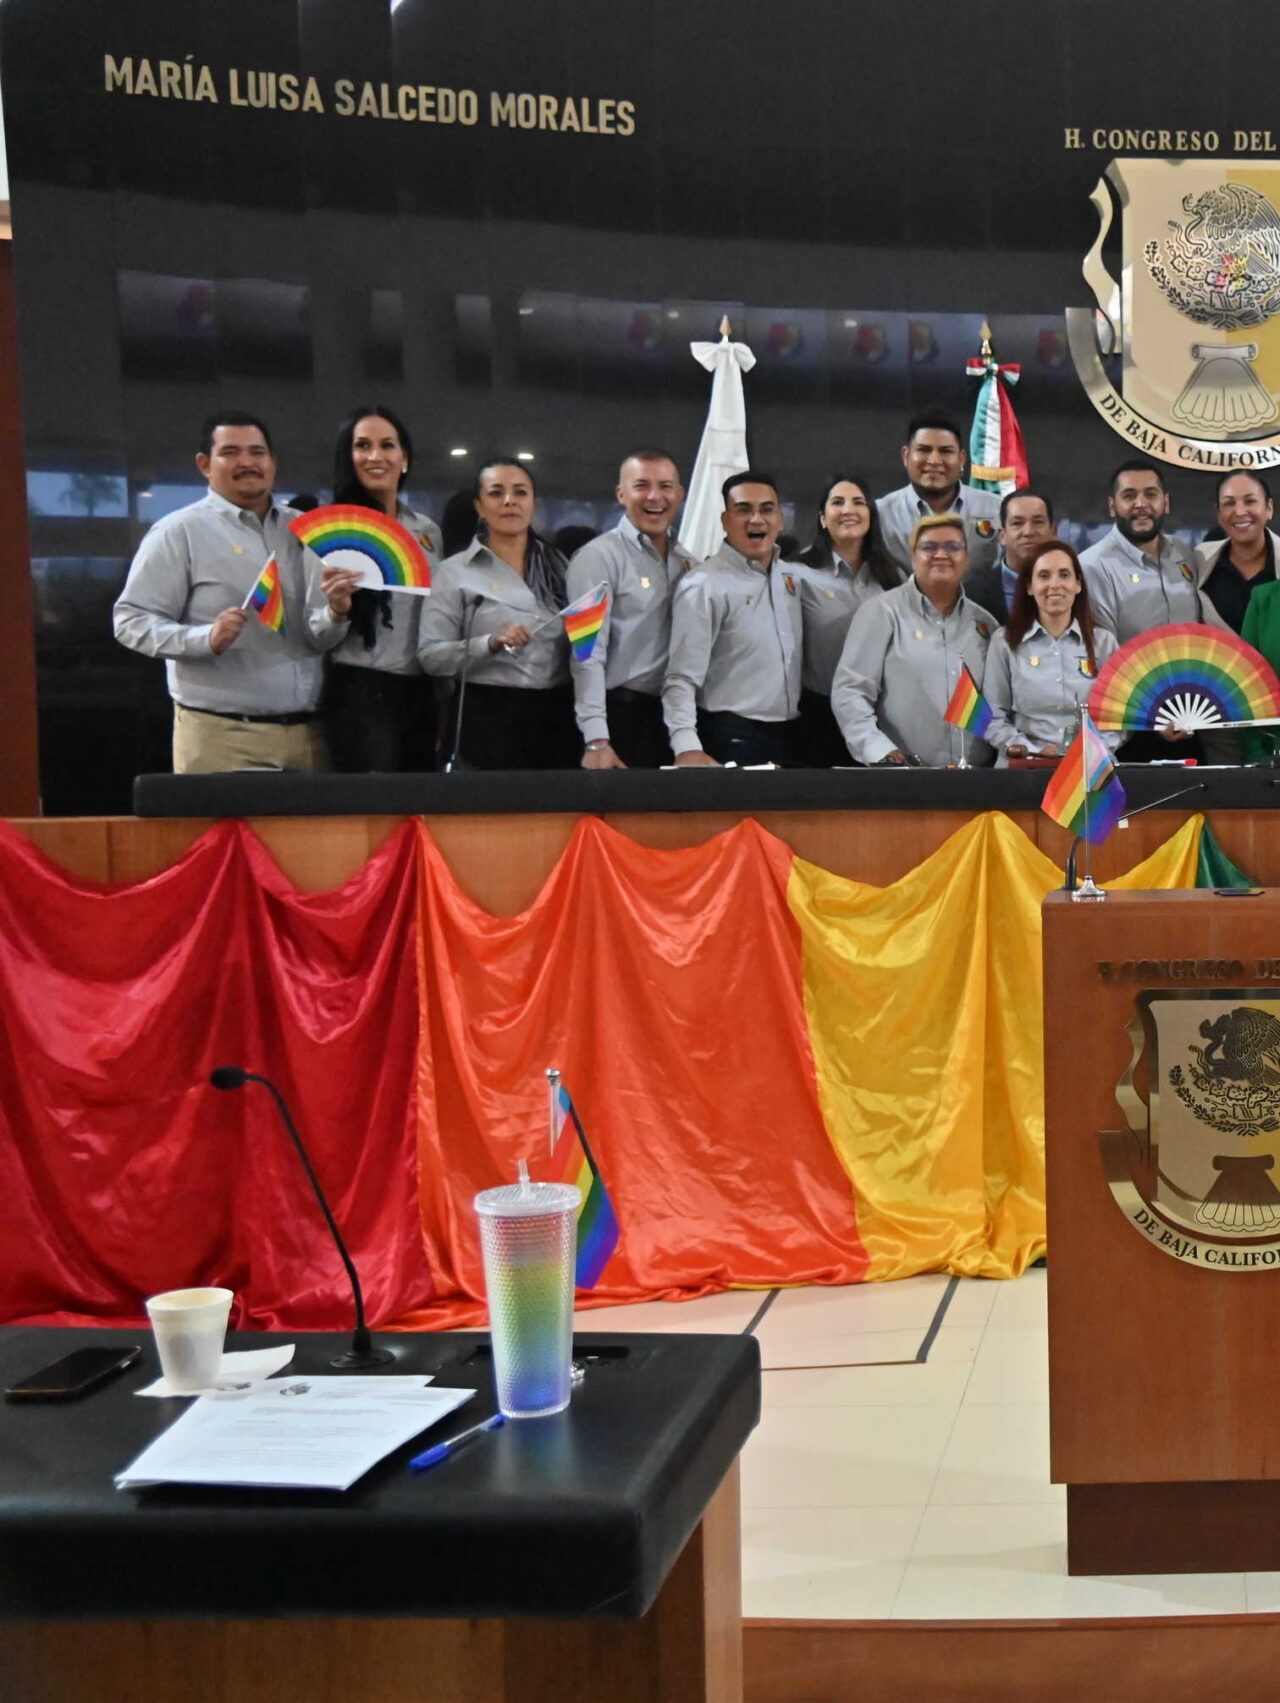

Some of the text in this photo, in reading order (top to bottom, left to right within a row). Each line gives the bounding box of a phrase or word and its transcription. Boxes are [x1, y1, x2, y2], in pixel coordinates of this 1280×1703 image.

[104, 54, 635, 136] MARÍA LUISA SALCEDO MORALES
[1064, 128, 1085, 149] H.
[1092, 129, 1219, 151] CONGRESO
[1233, 131, 1276, 151] DEL
[1100, 393, 1127, 423] DE
[1125, 420, 1167, 453] BAJA
[1133, 1208, 1160, 1236] DE
[1157, 1229, 1200, 1261] BAJA
